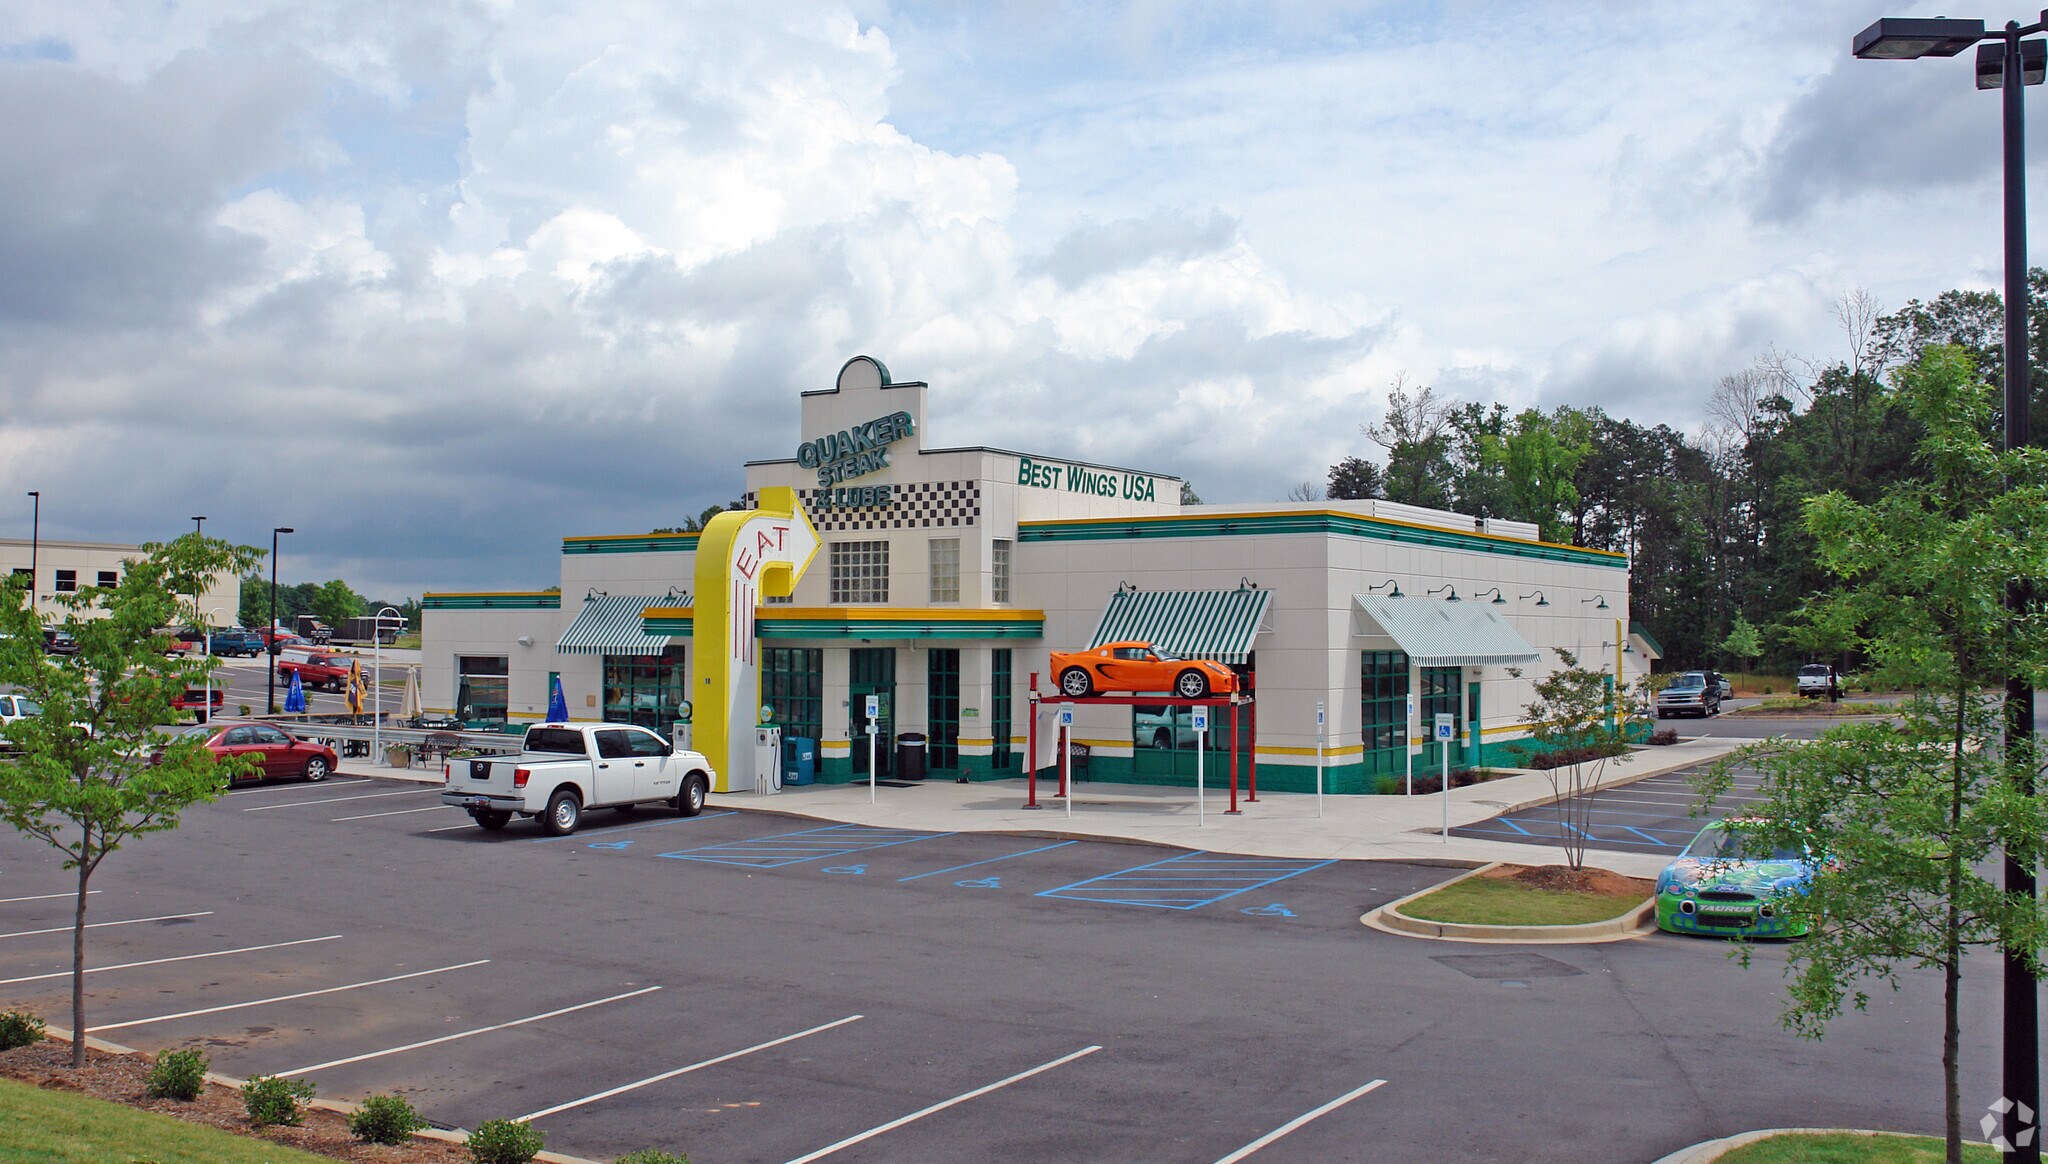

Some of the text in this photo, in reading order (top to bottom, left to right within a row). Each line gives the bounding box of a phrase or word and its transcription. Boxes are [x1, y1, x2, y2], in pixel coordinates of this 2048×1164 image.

[796, 411, 913, 469] QUAKER
[817, 446, 889, 487] STEAK
[1018, 457, 1155, 502] BEST WINGS USA
[815, 485, 892, 509] & LUBE
[736, 526, 790, 581] EAT
[1699, 904, 1754, 913] TAURUS
